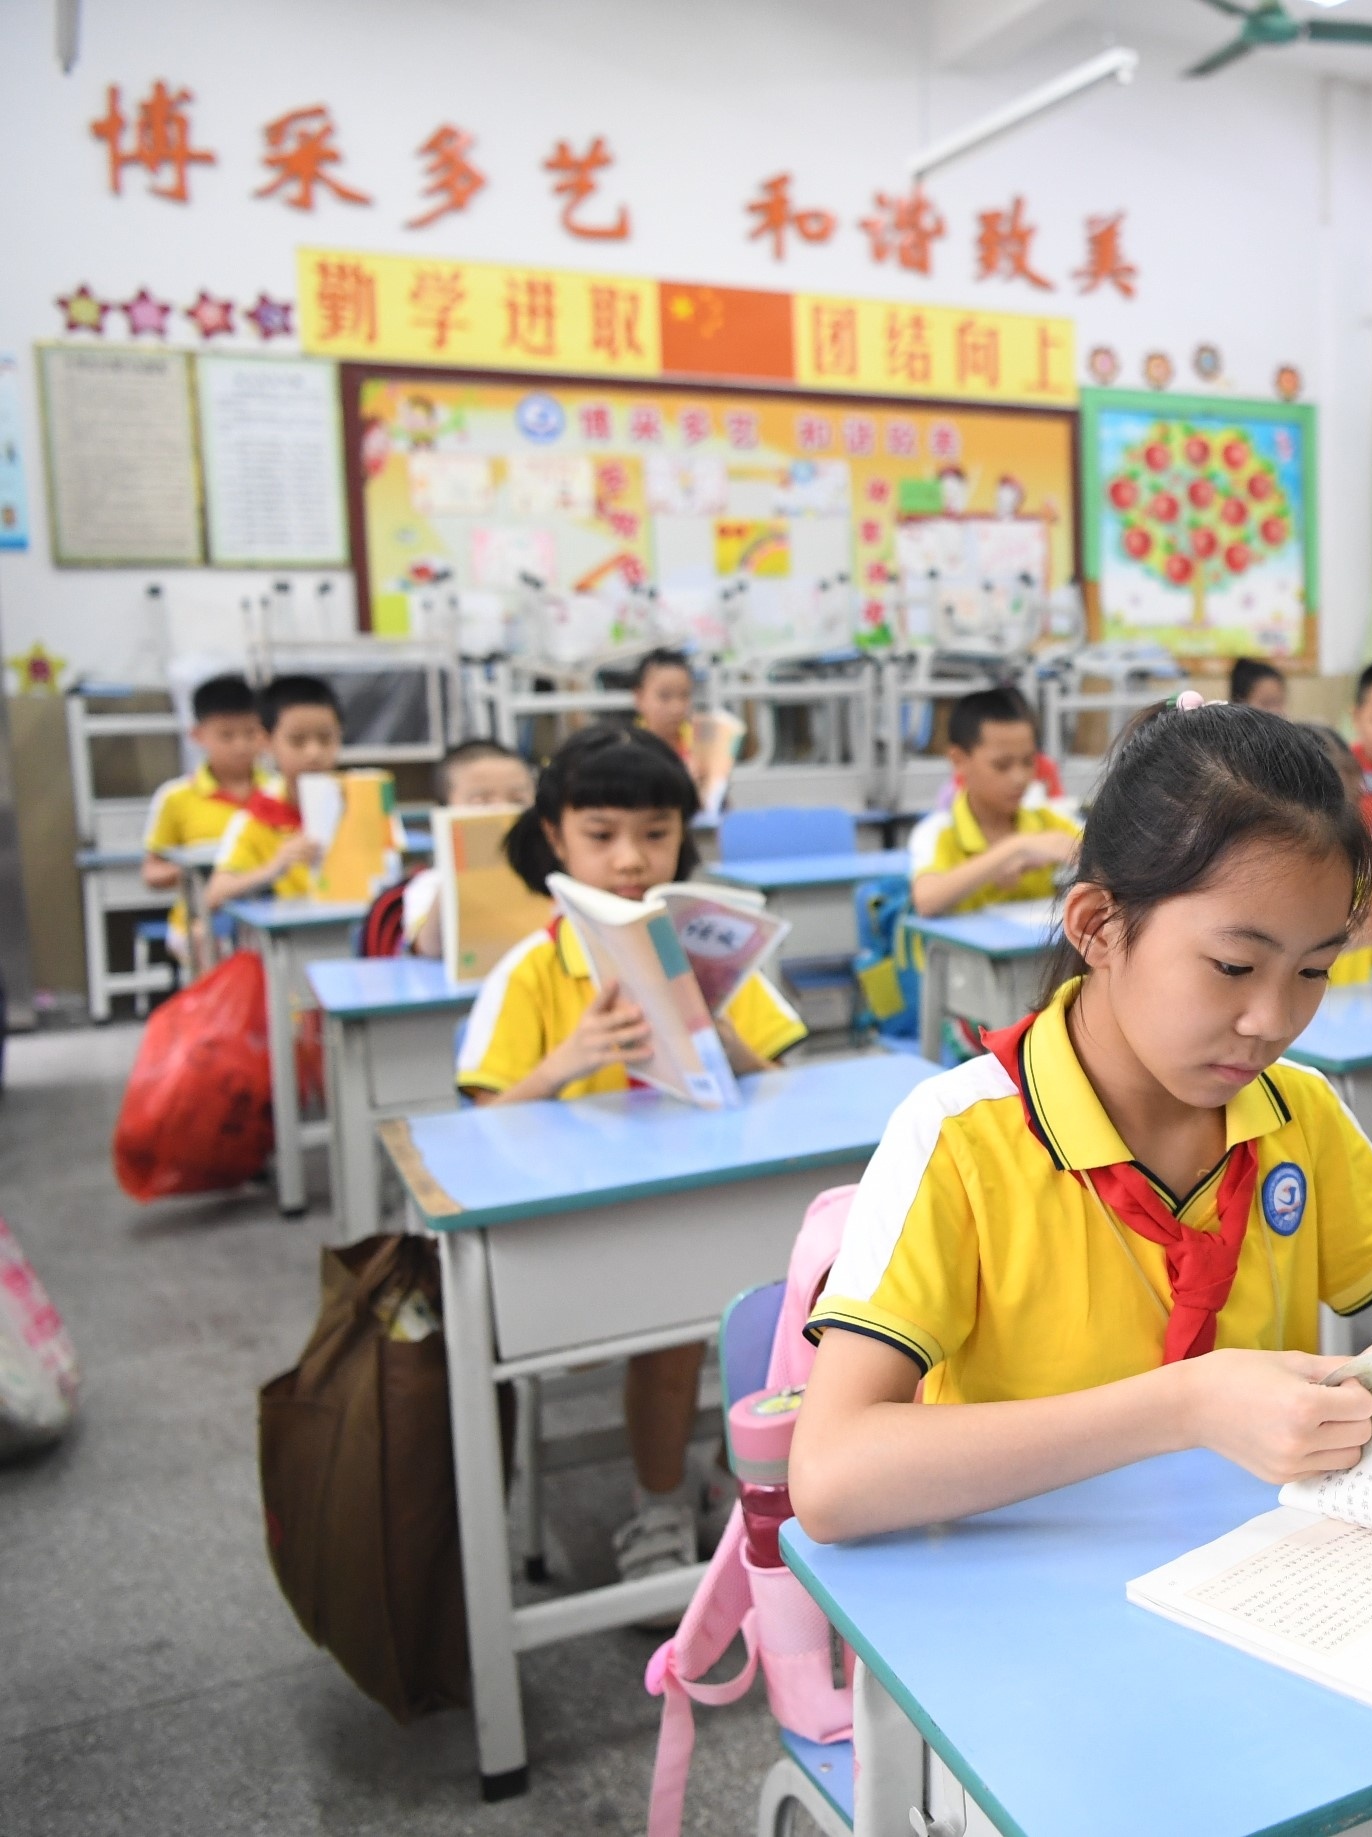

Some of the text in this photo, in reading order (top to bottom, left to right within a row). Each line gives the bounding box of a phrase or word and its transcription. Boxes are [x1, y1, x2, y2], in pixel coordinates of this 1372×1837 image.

[89, 79, 1138, 300] 博采多艺 和谐致美
[315, 258, 1067, 397] 勤学进取 团结向上
